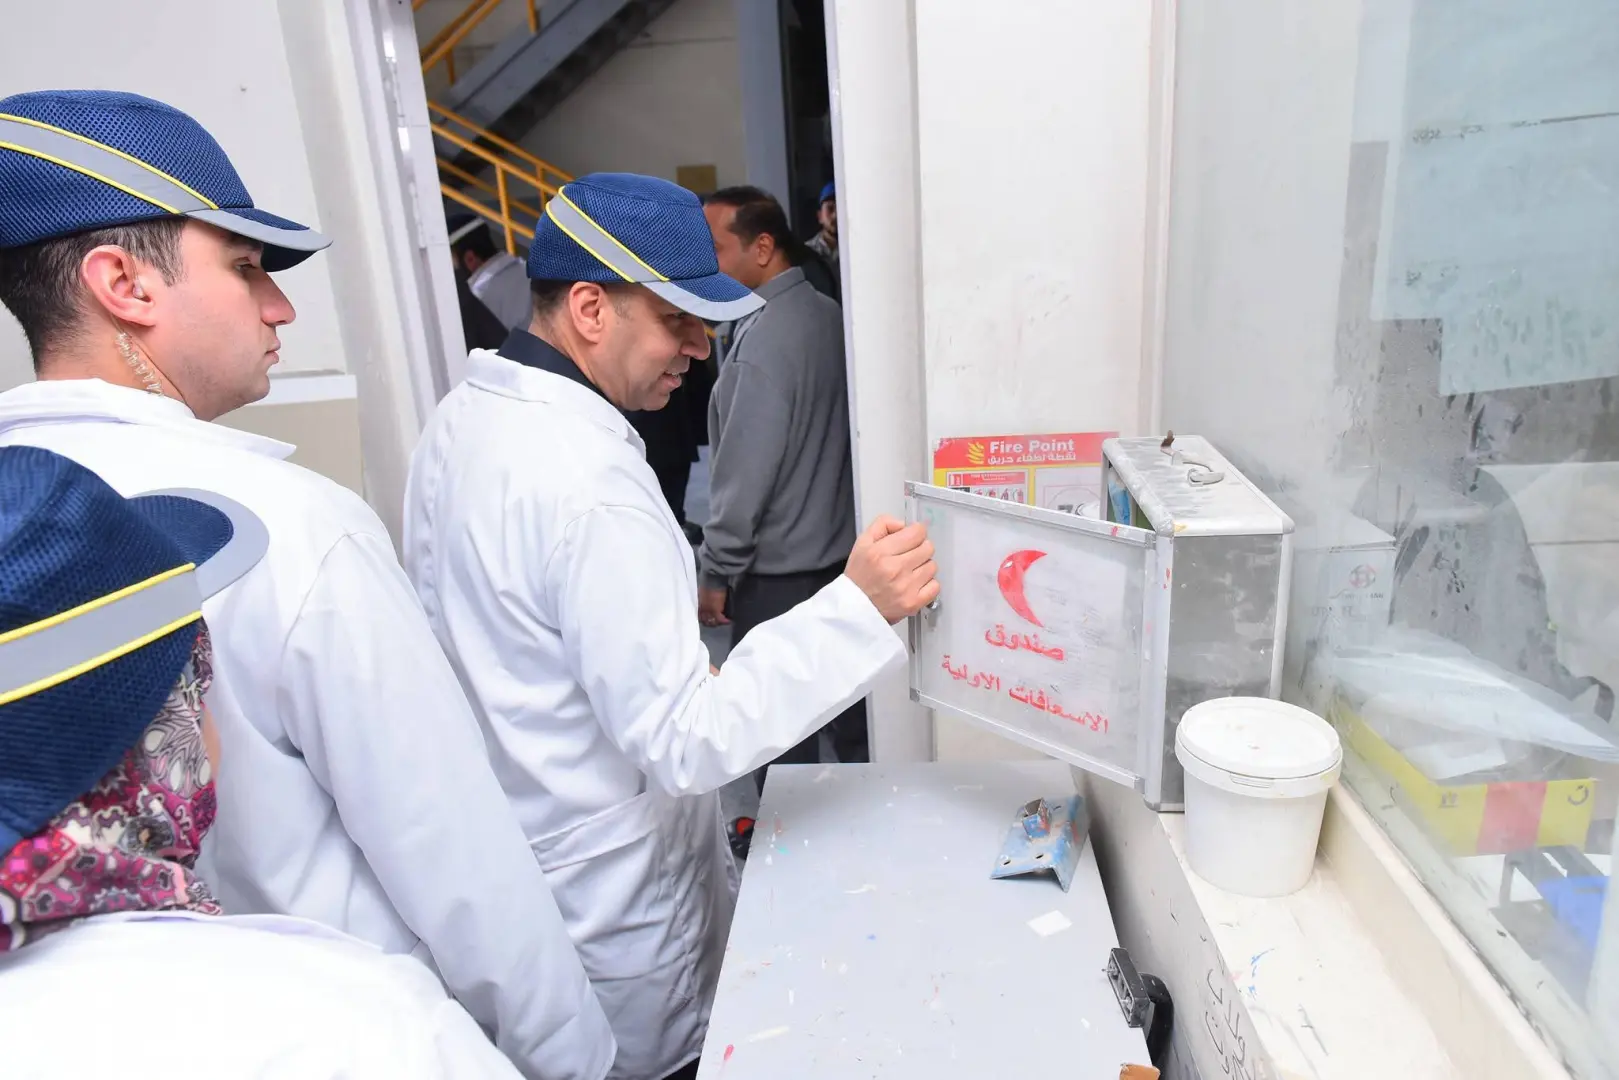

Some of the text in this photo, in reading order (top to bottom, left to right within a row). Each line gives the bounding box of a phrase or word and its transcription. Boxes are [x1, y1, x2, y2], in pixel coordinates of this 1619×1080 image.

[989, 438, 1075, 454] Fire Point
[987, 455, 1014, 465] حريق
[985, 624, 1065, 661] صندوق
[941, 655, 1109, 734] الاسعافات الاولية
